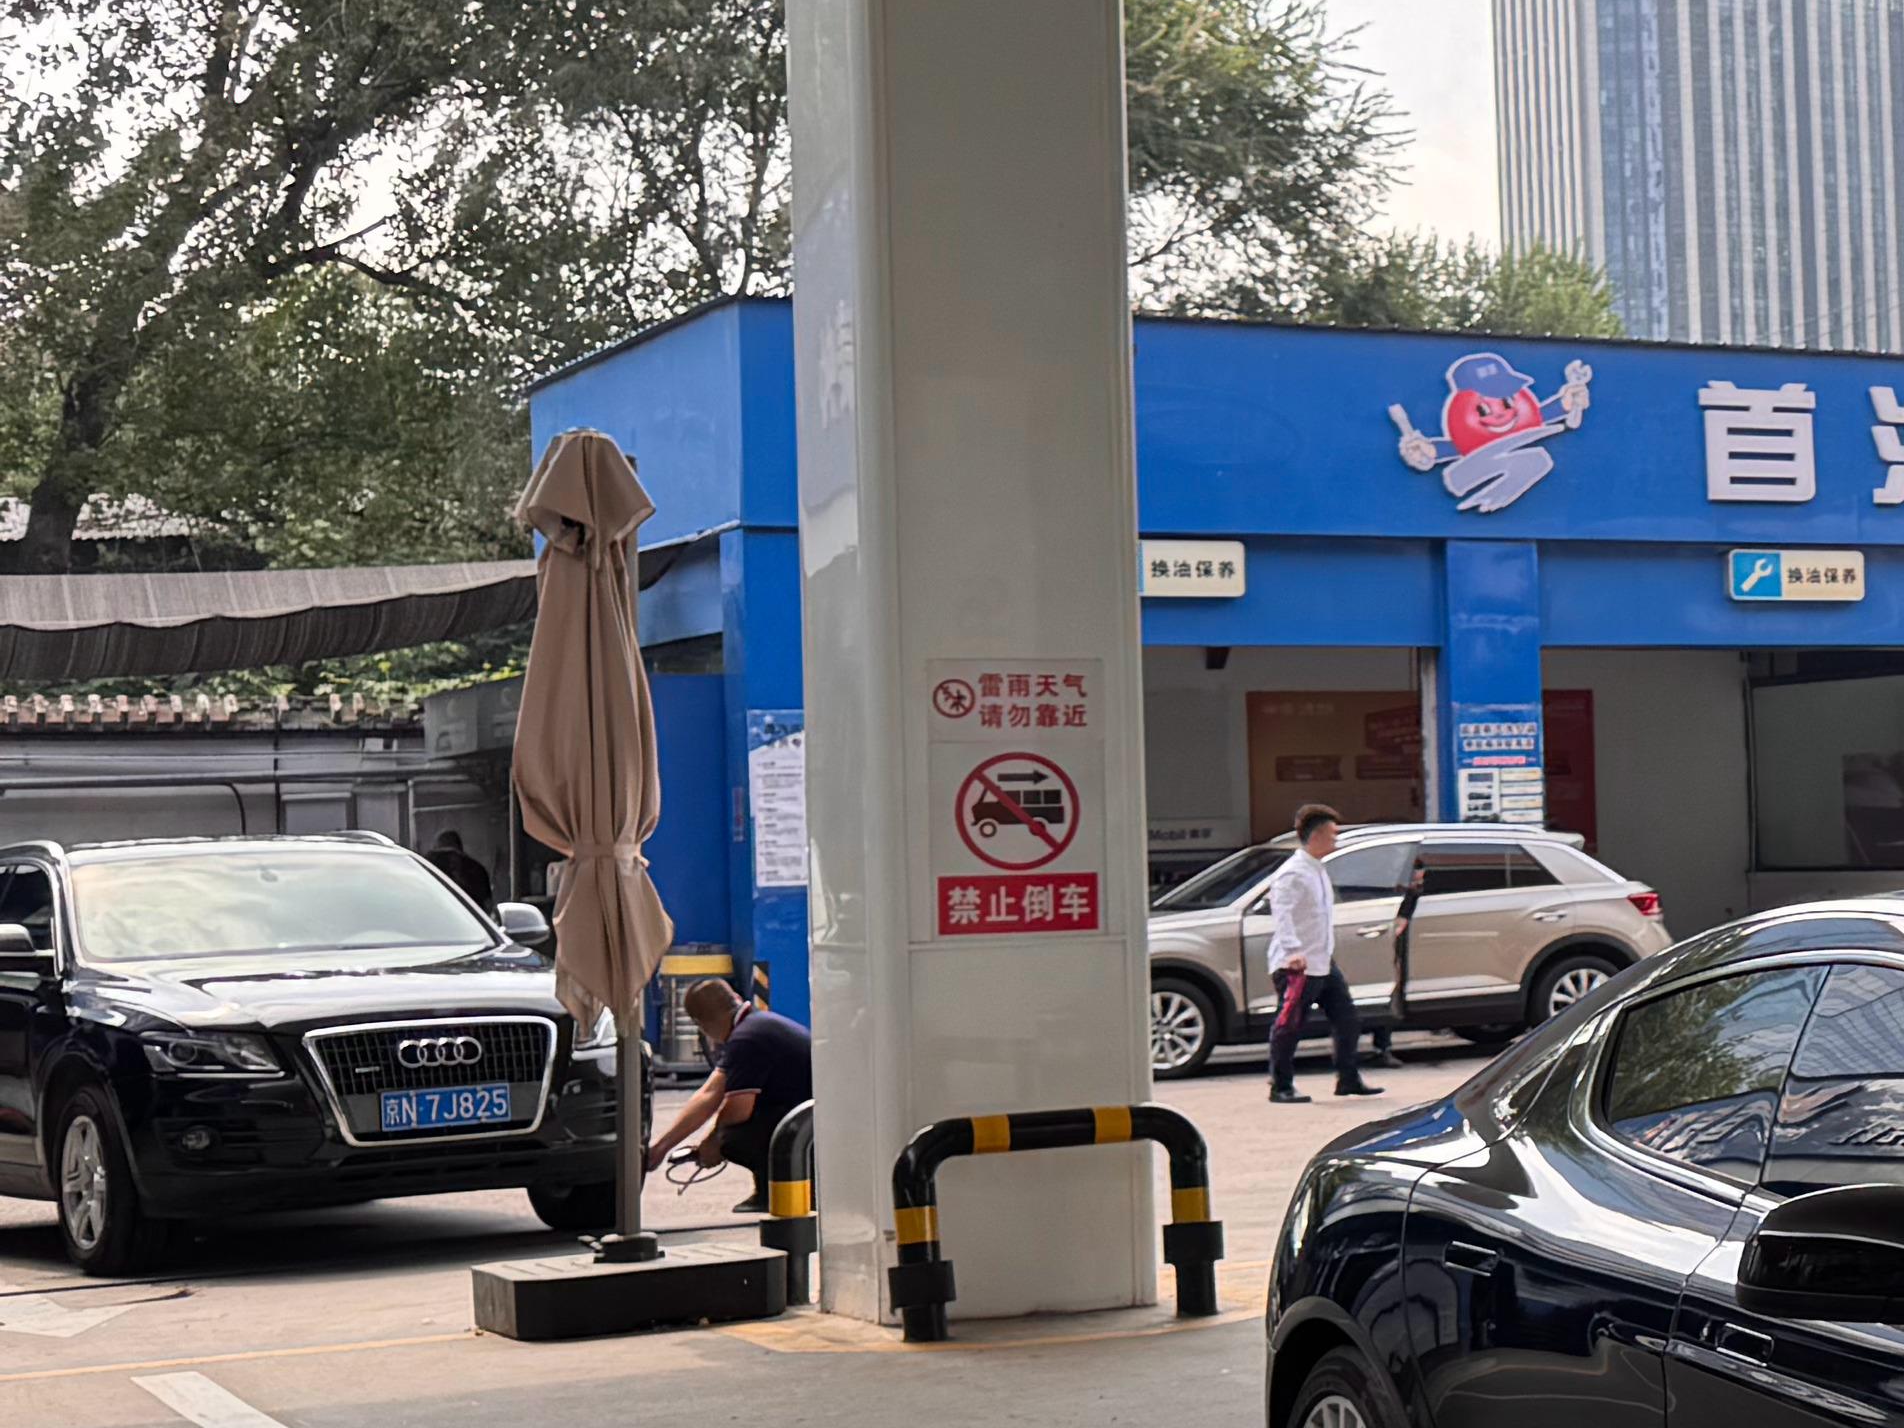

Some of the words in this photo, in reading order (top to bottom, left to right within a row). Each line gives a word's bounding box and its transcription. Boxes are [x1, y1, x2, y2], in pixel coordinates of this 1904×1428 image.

[1151, 559, 1236, 579] 换油保养
[1787, 567, 1858, 585] 换油保养
[979, 672, 1088, 699] 雷雨天气
[979, 704, 1088, 729] 请勿靠近
[948, 883, 1092, 925] 禁止倒车
